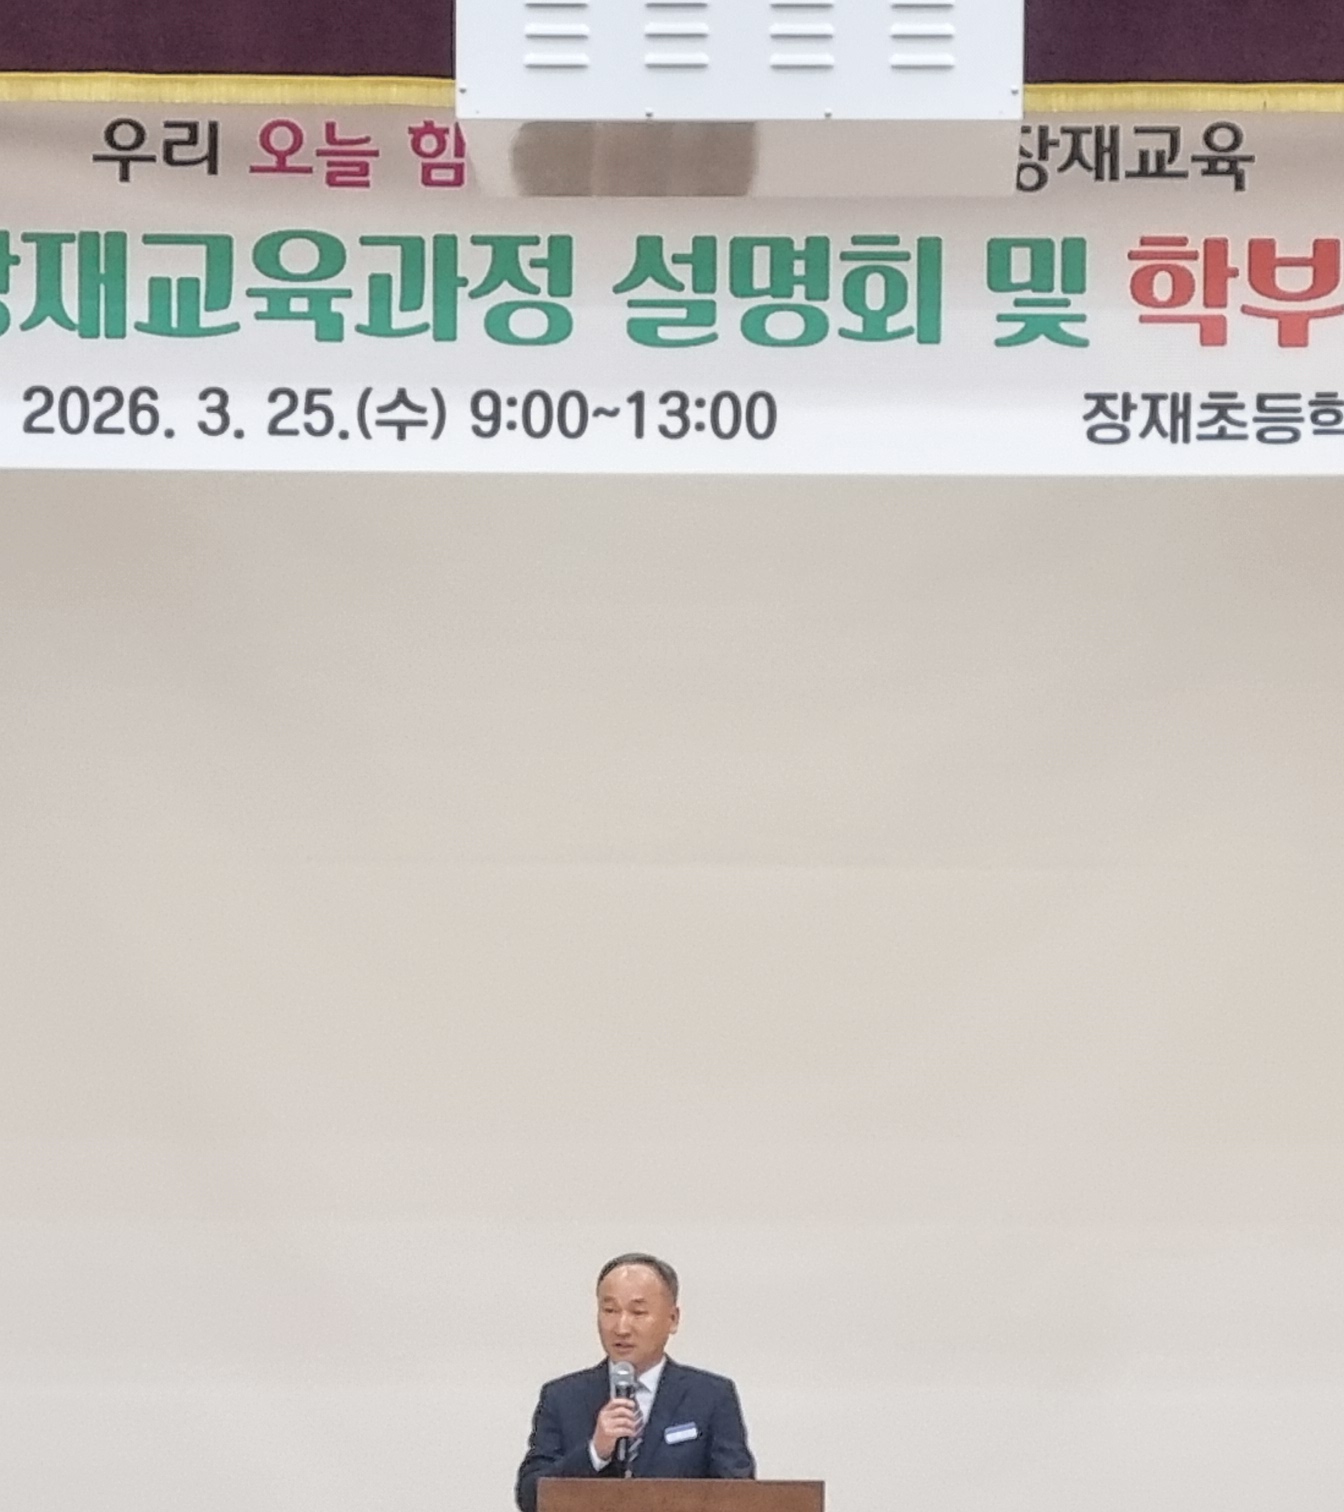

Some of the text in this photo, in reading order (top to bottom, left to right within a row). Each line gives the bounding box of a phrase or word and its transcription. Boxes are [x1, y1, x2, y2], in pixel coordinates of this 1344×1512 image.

[92, 117, 219, 183] 우리
[249, 118, 380, 188] 오늘
[613, 234, 942, 348] 설명회
[987, 236, 1090, 348] 및
[21, 384, 779, 442] 2026. 3. 25.(수) 9:00~13:00
